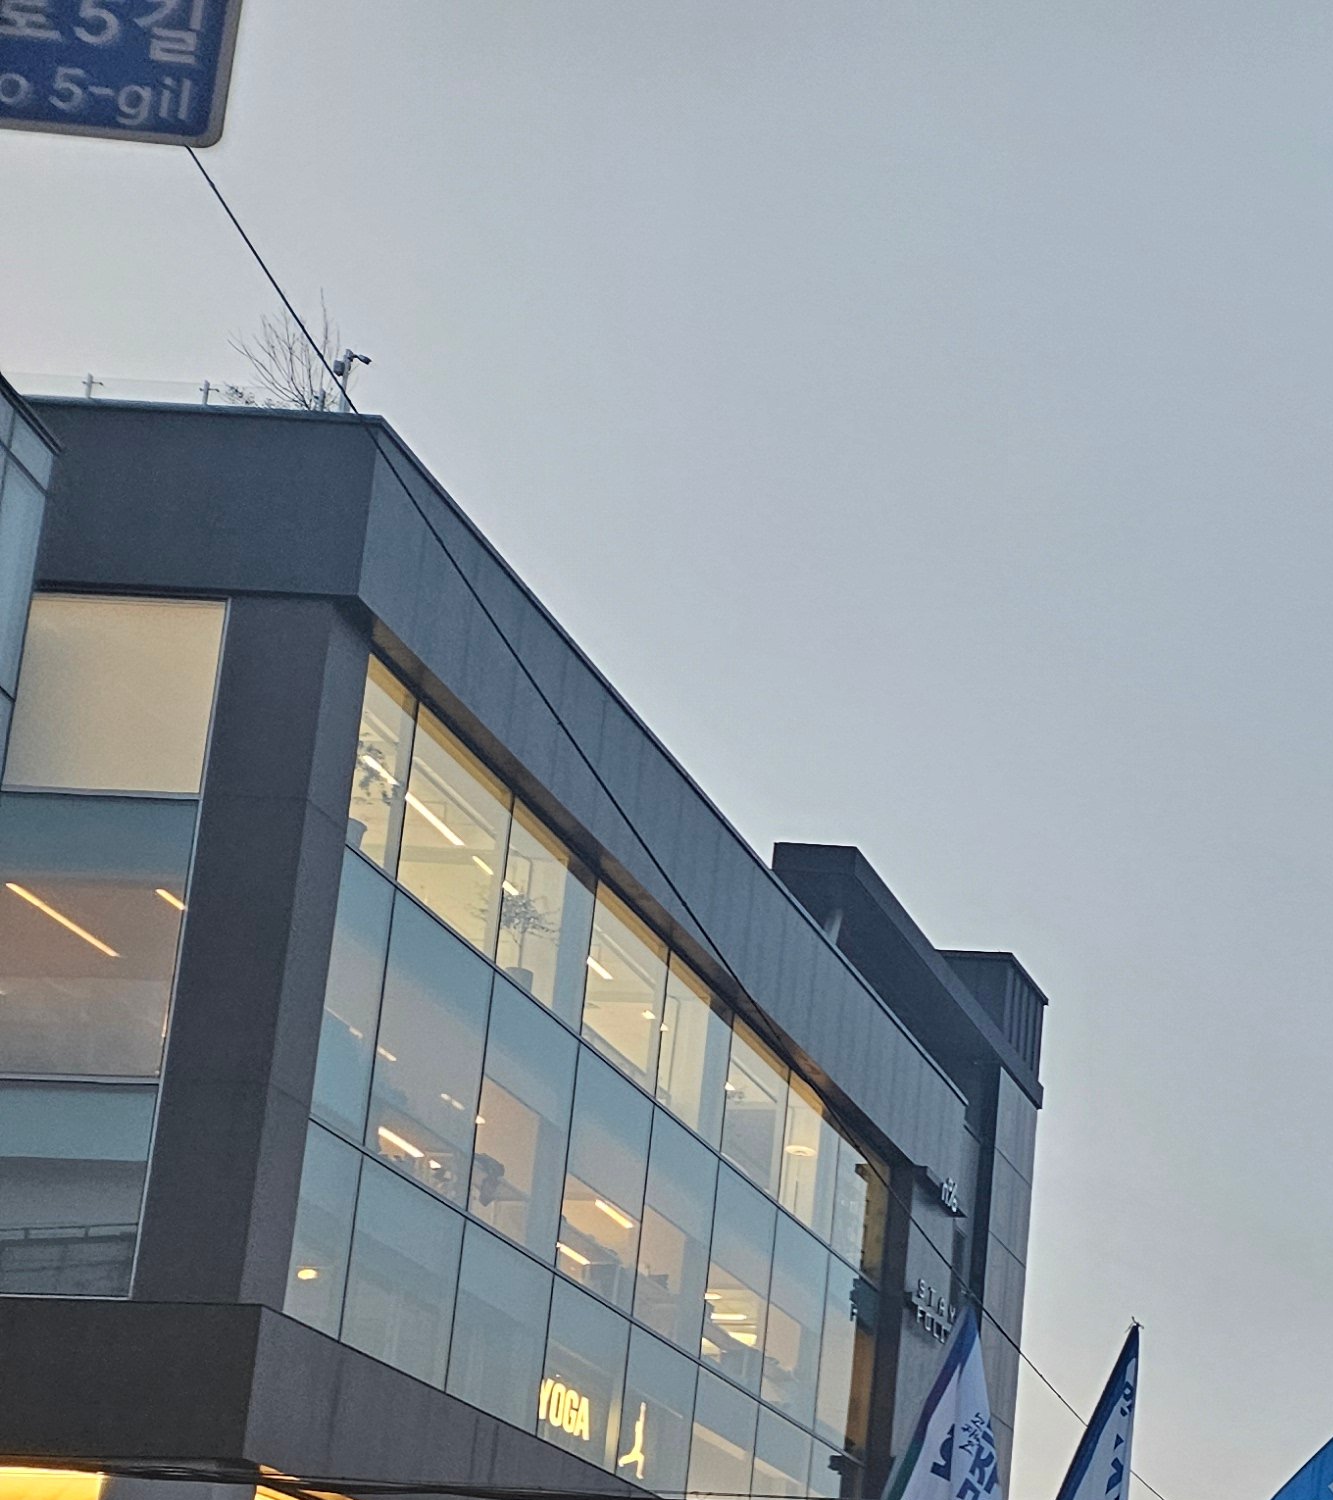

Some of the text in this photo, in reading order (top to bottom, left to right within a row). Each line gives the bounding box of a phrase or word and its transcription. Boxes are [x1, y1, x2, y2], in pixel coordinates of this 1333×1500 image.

[50, 67, 193, 126] 5-gil
[917, 1278, 957, 1323] STAY
[539, 1378, 590, 1441] YOGA
